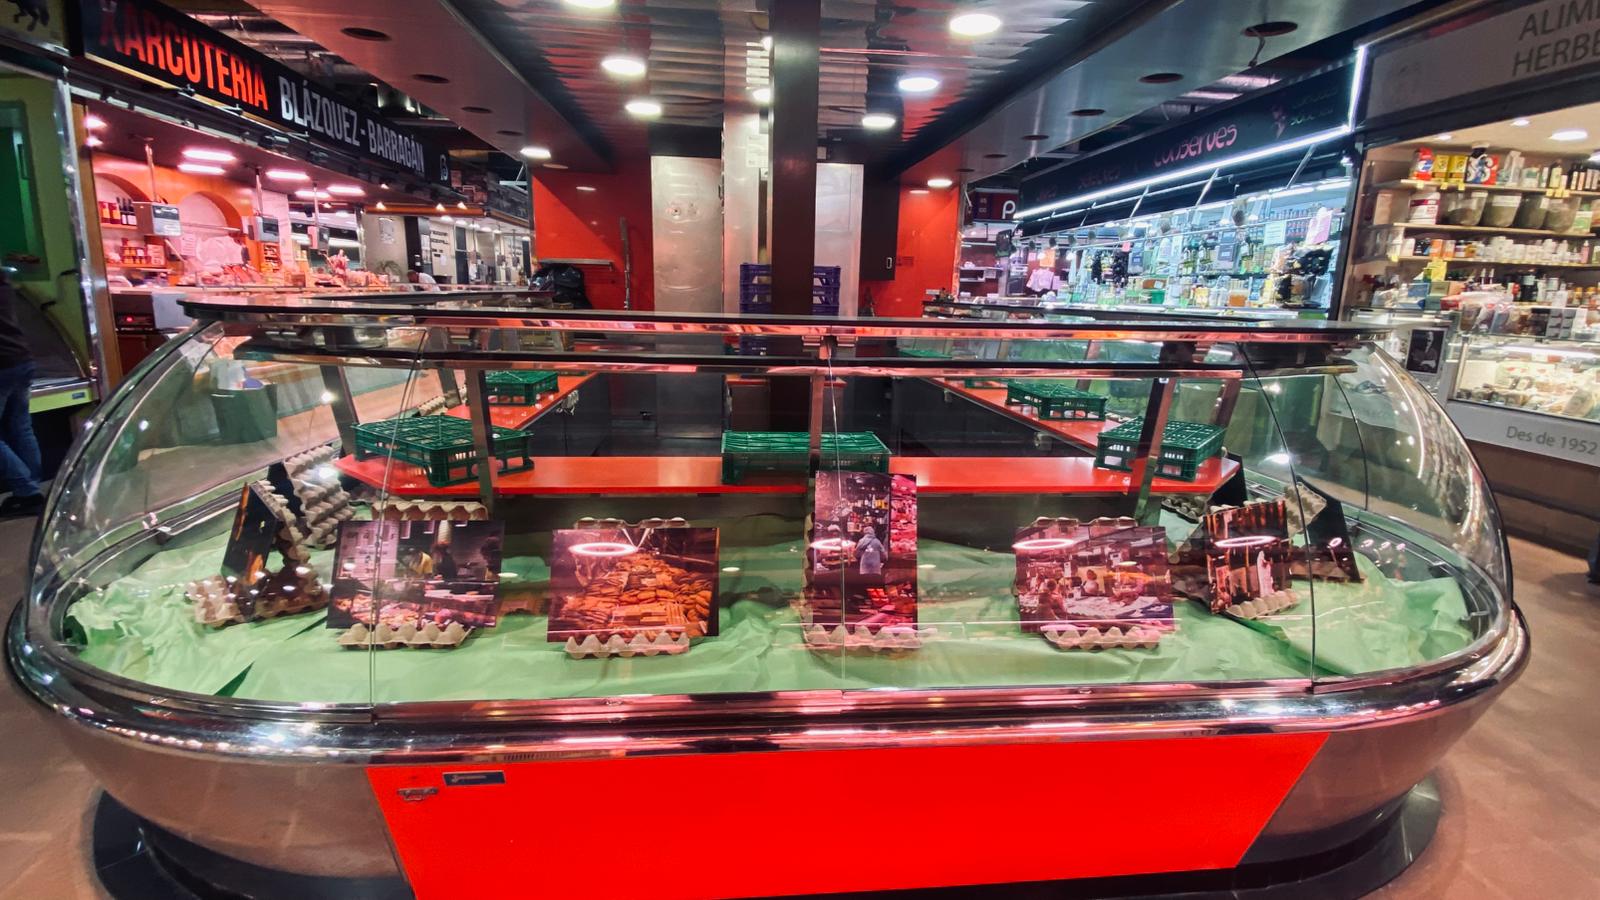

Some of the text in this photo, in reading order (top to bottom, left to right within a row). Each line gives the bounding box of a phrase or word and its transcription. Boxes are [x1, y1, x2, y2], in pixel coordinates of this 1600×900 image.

[1518, 0, 1600, 41] ALIM
[1506, 425, 1598, 456] Des de 1952
